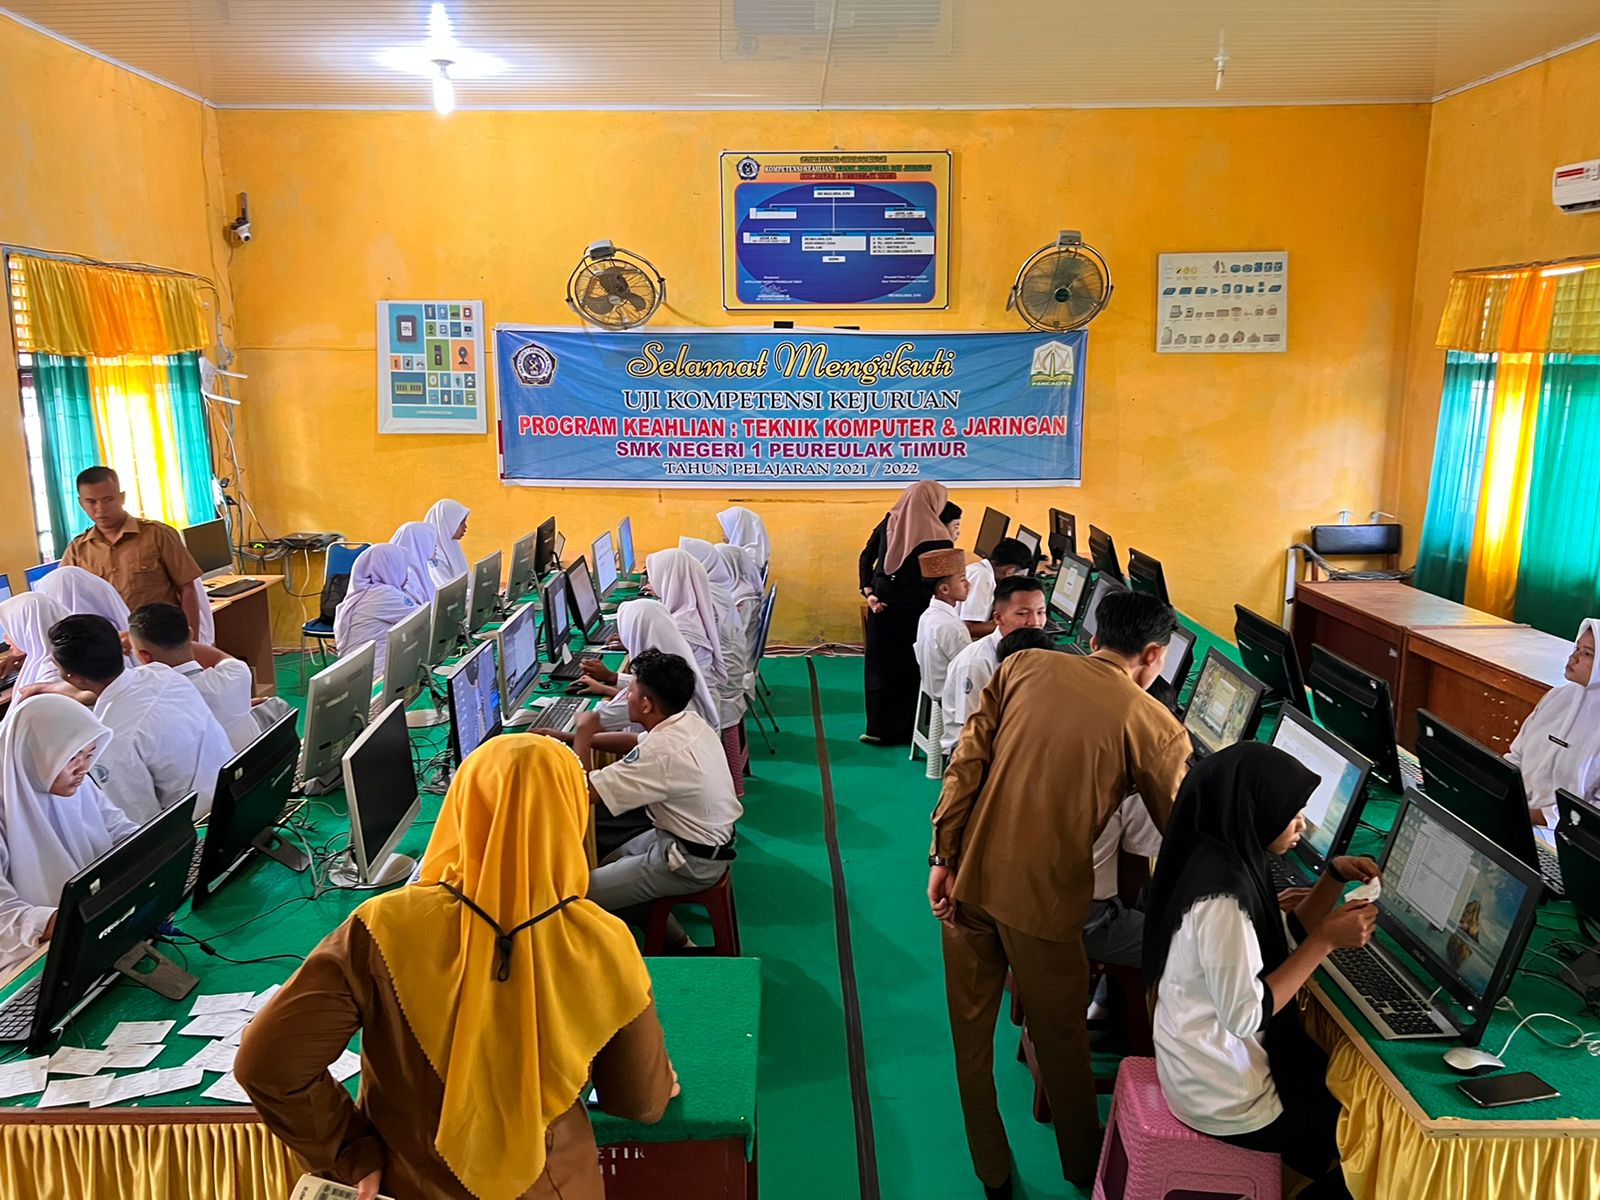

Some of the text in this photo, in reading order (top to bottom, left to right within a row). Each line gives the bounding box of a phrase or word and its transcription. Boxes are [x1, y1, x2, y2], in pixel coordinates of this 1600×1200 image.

[628, 341, 956, 385] Selamat Mengikuti
[623, 390, 960, 412] UJI KOMPETENSI KEJURUAN
[519, 416, 617, 436] PROGRAM
[624, 418, 725, 437] KEAHLIAN
[743, 419, 818, 437] TEKNIK
[824, 418, 935, 437] KOMPUTER
[942, 418, 955, 436] &
[963, 416, 1067, 436] JARINGAN
[616, 442, 967, 457] SMK NEGERI 1 PEUREULAK TIMUR
[664, 462, 728, 475] TAHUN
[732, 462, 829, 476] PELAJARAN
[834, 463, 867, 475] 2021
[885, 463, 919, 475] 2022
